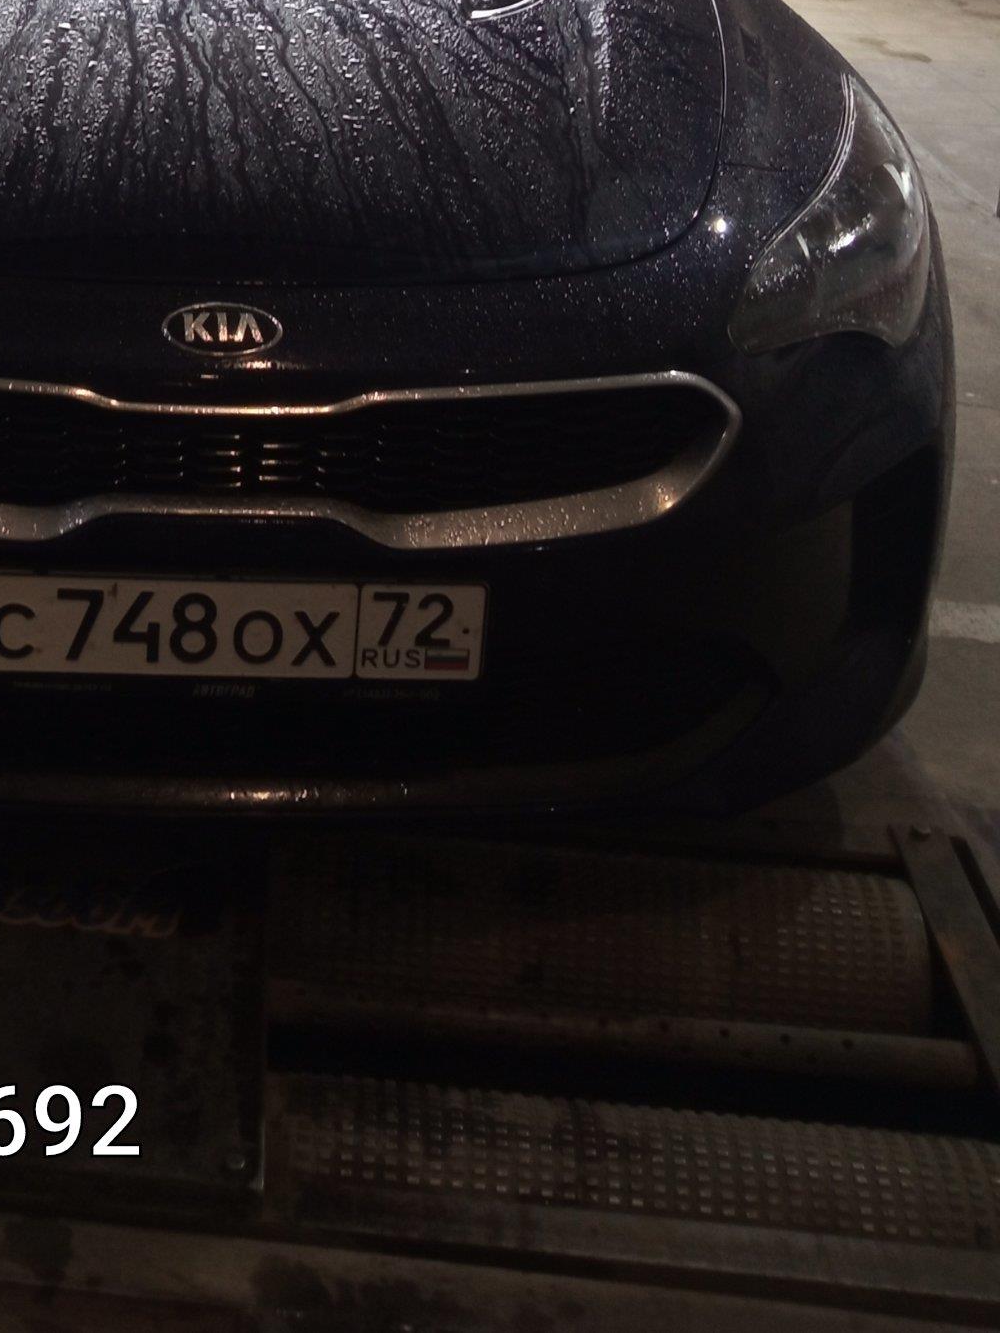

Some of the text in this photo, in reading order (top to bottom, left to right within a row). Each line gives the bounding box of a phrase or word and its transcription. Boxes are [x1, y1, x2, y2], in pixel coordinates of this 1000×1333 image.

[182, 312, 263, 343] KIA
[373, 591, 454, 648] 72
[361, 649, 421, 668] RUS
